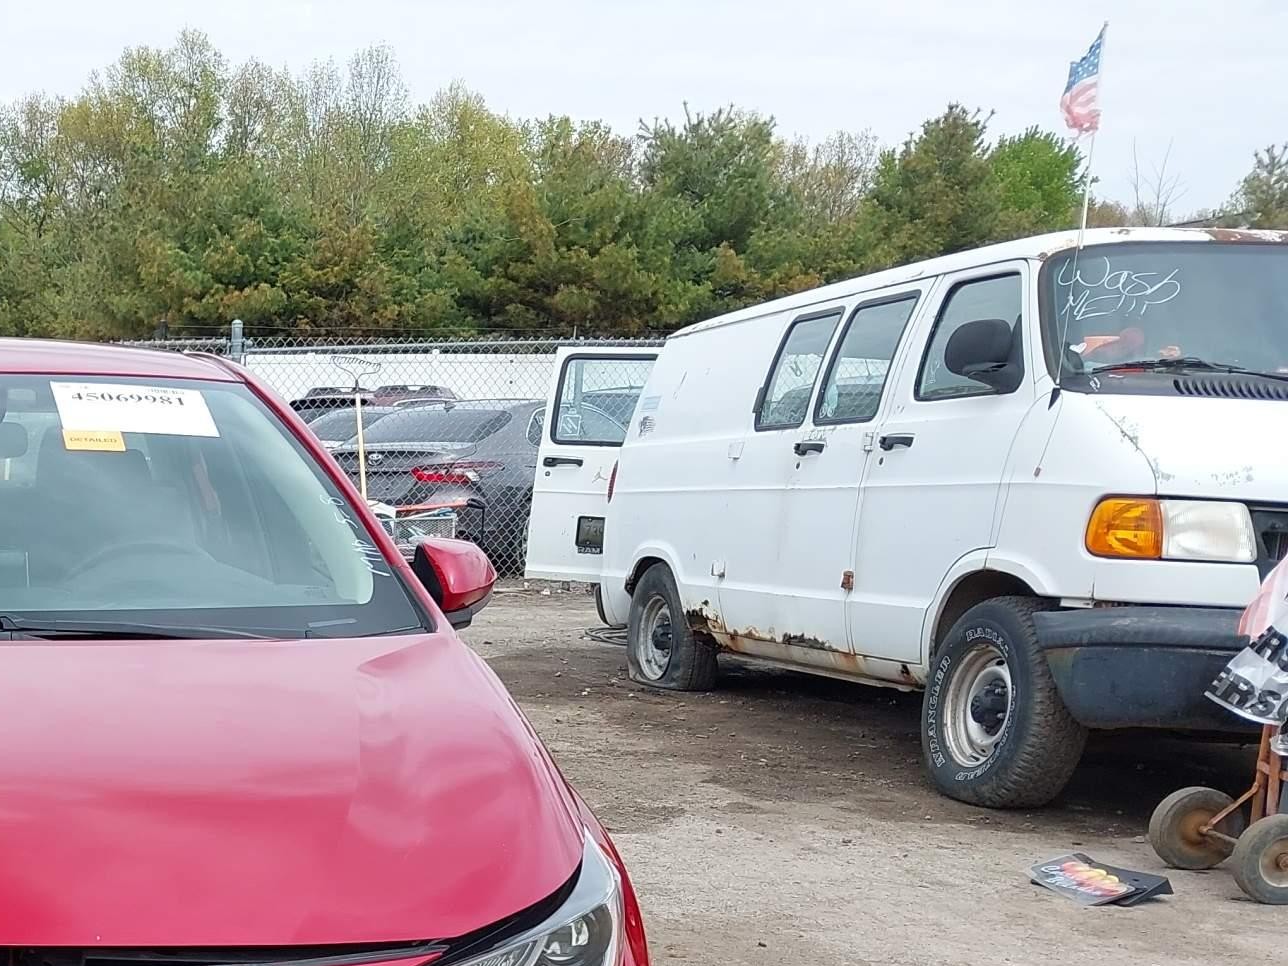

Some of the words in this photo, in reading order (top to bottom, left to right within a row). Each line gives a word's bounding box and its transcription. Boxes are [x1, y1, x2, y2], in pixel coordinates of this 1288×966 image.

[1057, 256, 1181, 304] Wash
[72, 392, 185, 406] 45069981
[69, 436, 118, 444] DETAILED
[578, 546, 601, 554] RAM
[926, 655, 952, 768] WRANGLER
